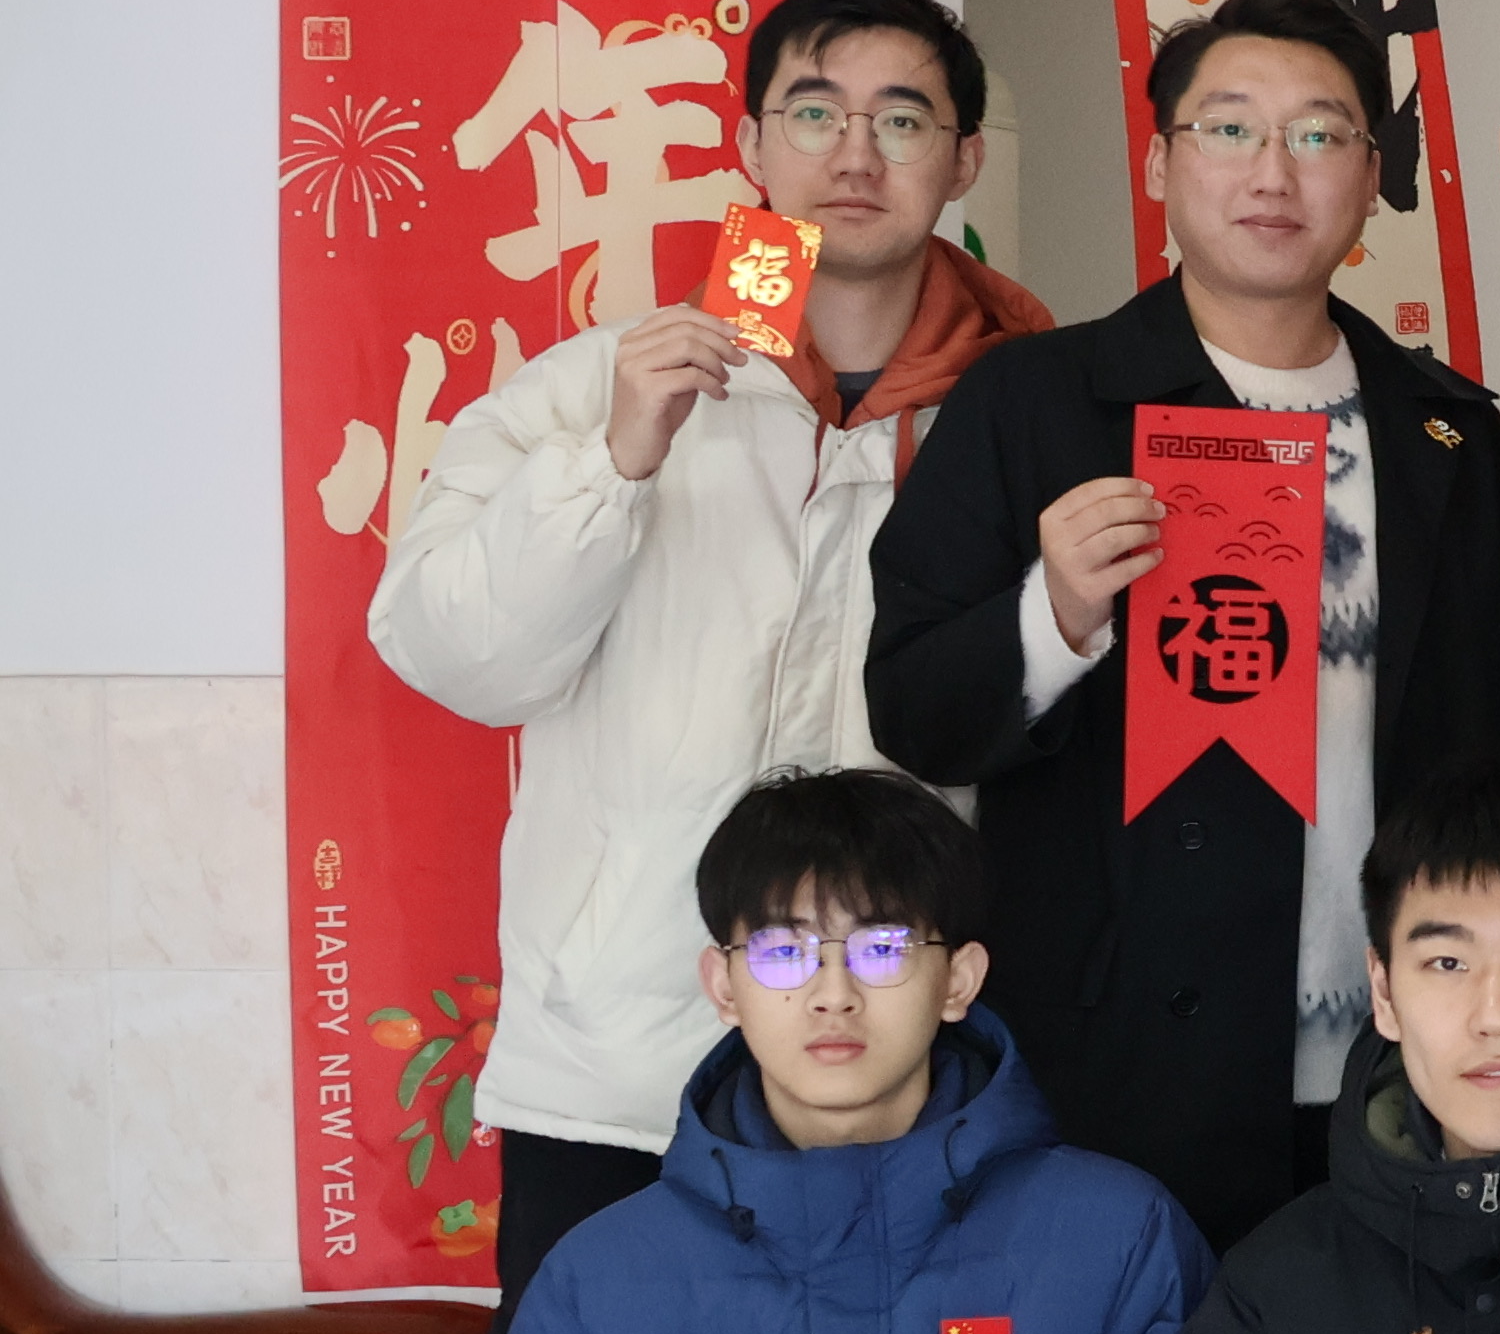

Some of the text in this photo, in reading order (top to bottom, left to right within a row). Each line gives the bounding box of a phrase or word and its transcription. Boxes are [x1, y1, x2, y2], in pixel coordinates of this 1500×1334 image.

[728, 238, 794, 307] 福
[1162, 578, 1278, 693] 福
[315, 905, 350, 1036] HAPPY
[319, 1053, 354, 1142] NEW
[321, 1155, 358, 1260] YEAR
